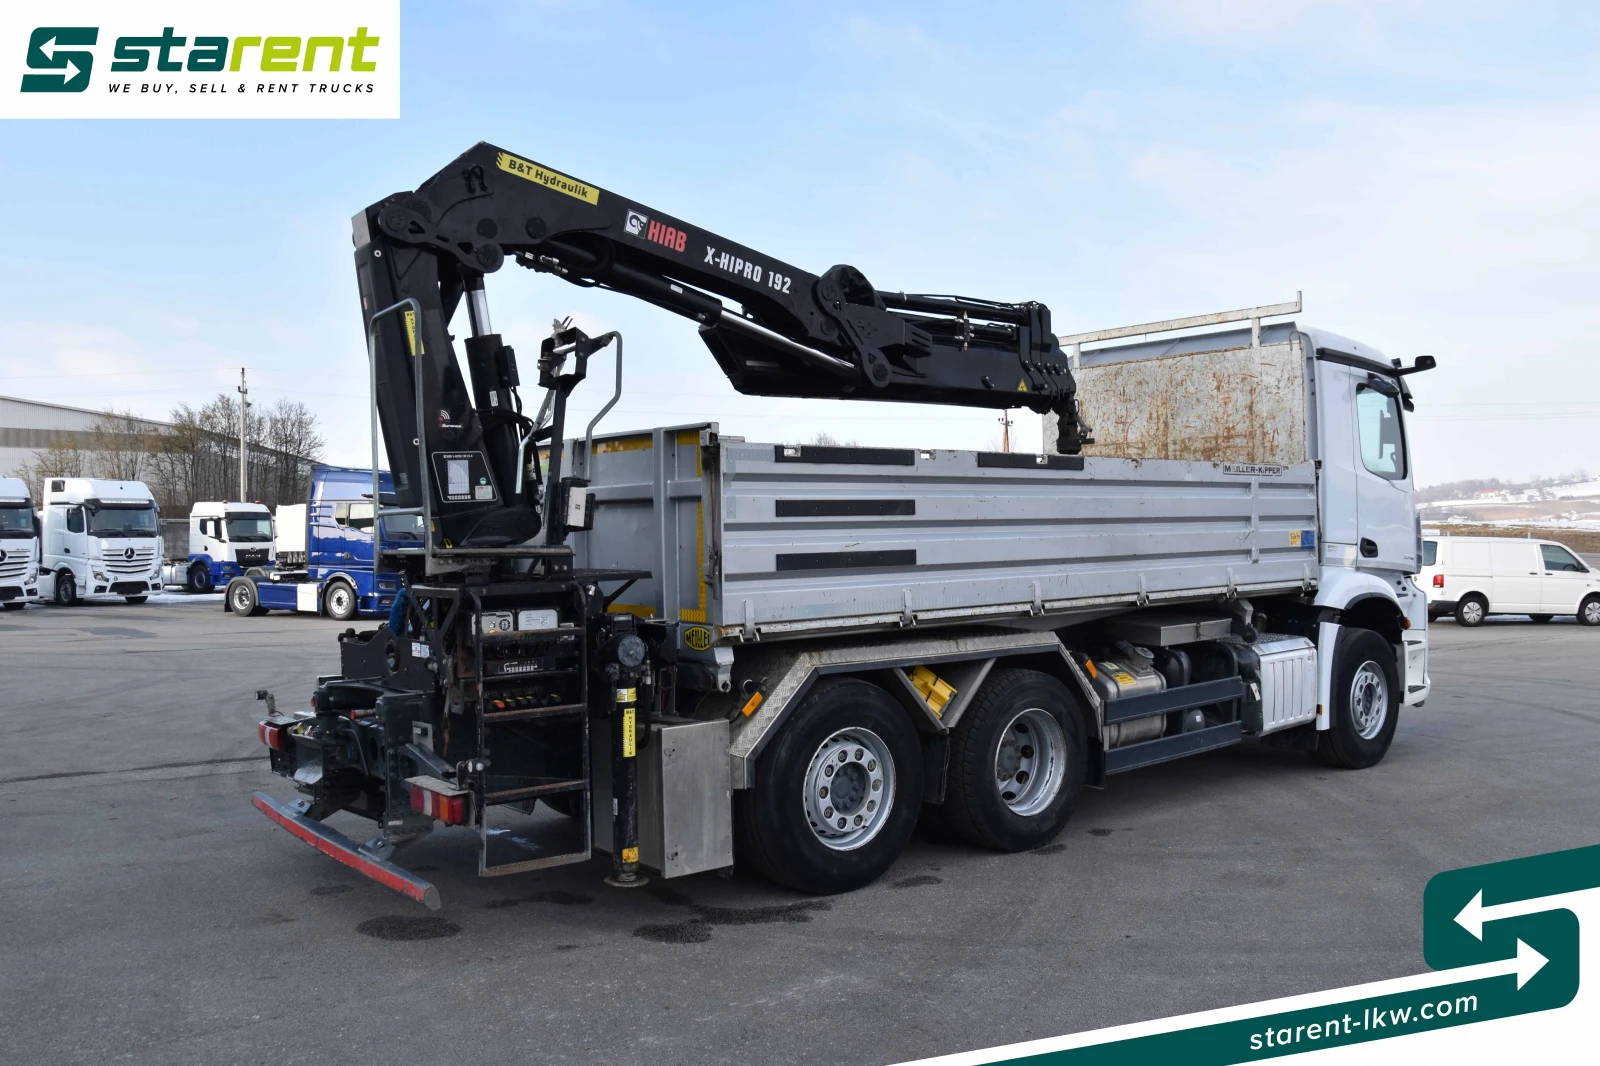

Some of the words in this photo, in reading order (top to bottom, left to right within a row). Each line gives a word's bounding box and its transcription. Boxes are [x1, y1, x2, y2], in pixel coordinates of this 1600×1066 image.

[508, 159, 533, 176] B&T
[535, 169, 588, 198] Hydraulik
[648, 220, 687, 252] HIAB
[704, 245, 762, 283] X-HIPRO
[768, 271, 792, 294] 192
